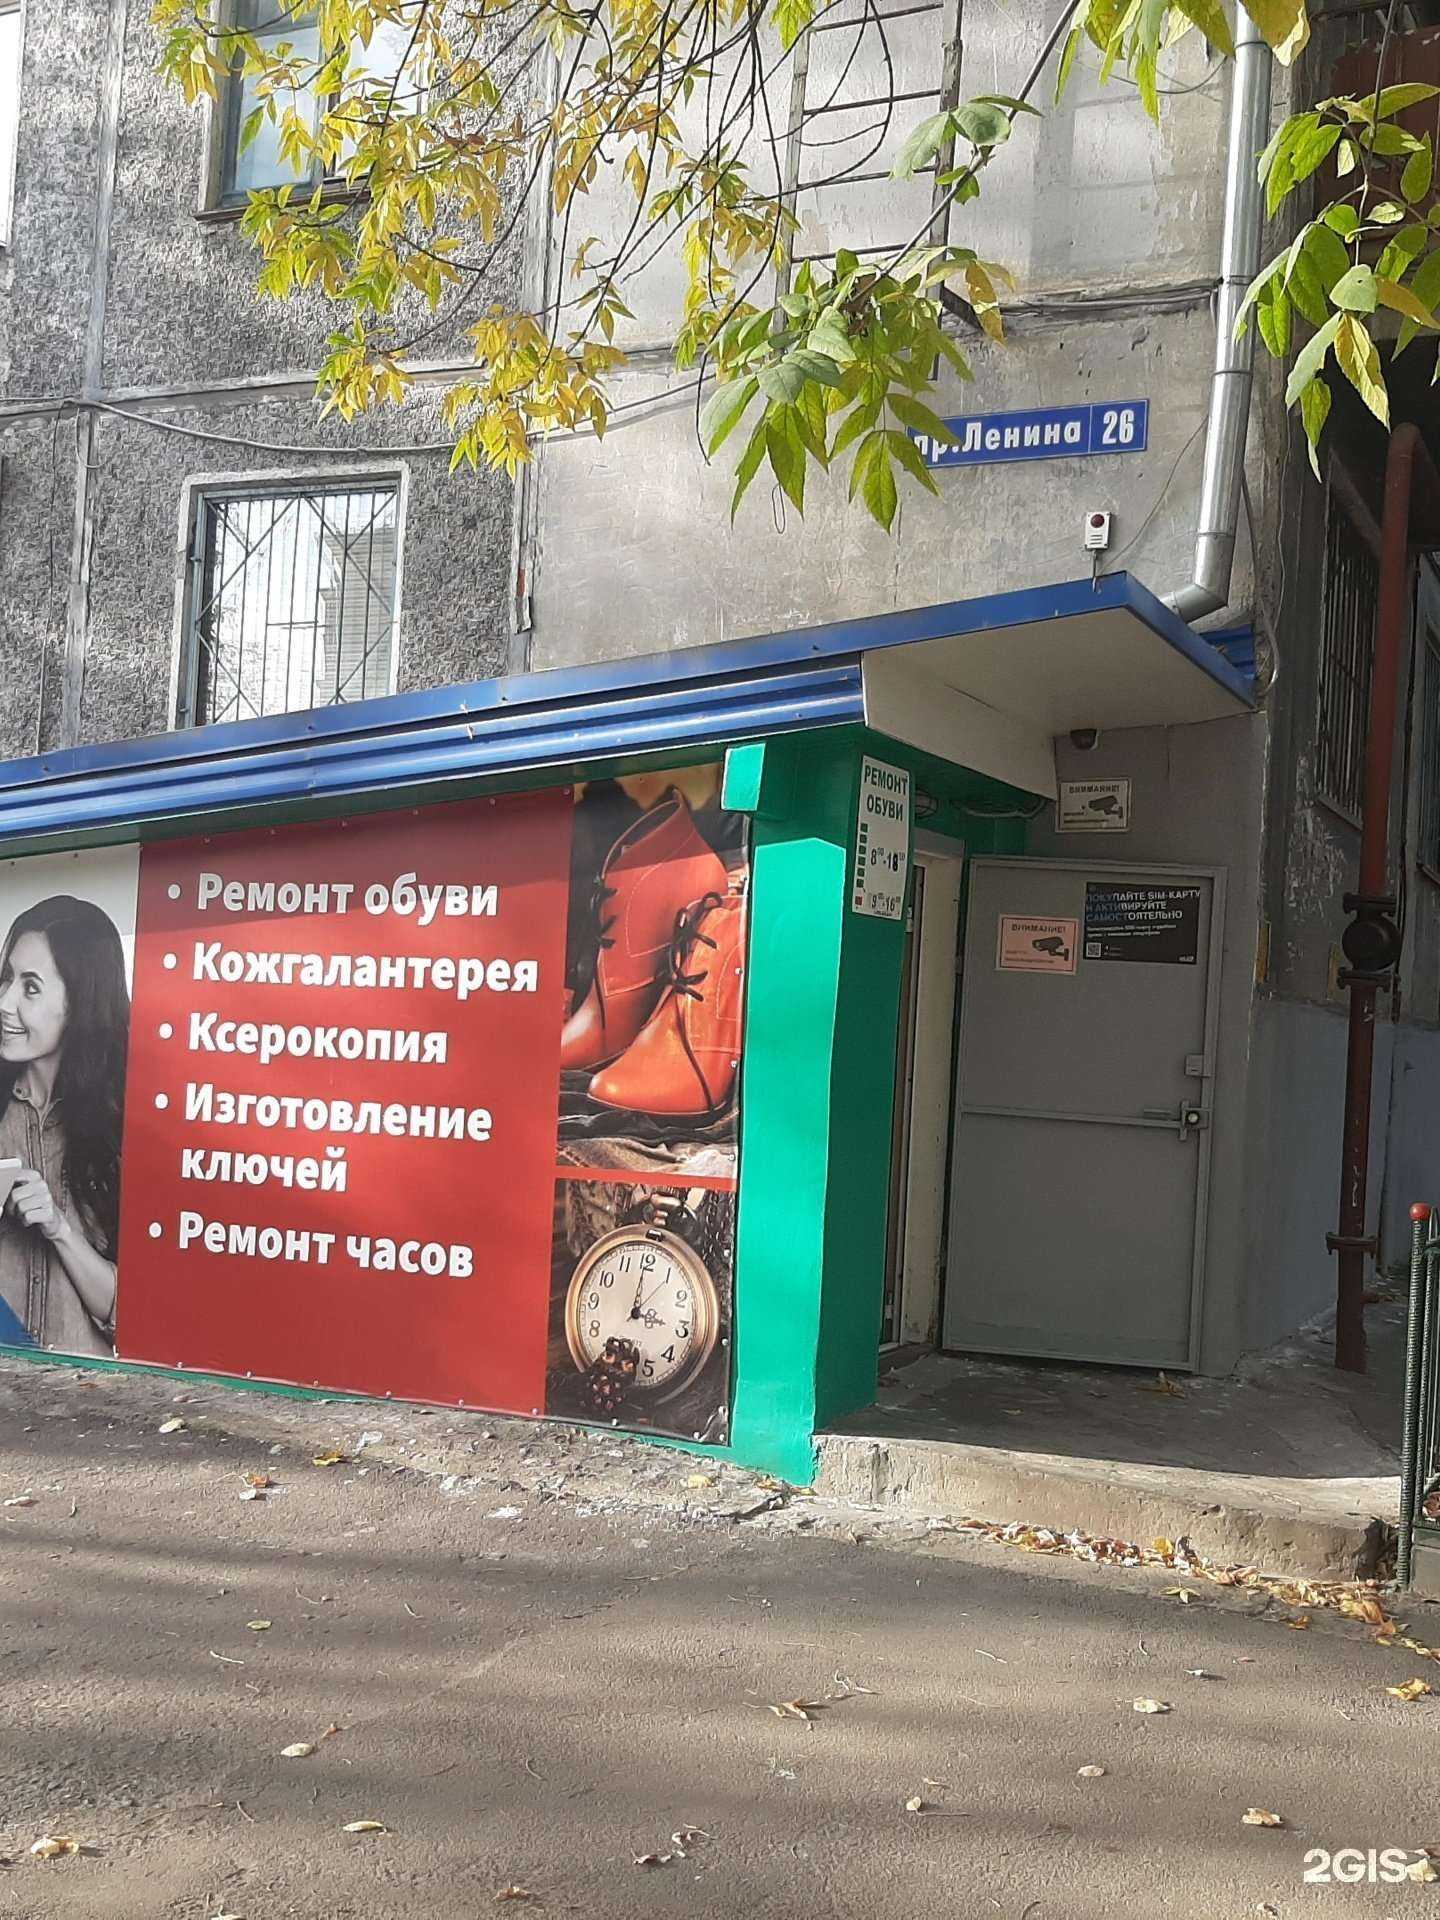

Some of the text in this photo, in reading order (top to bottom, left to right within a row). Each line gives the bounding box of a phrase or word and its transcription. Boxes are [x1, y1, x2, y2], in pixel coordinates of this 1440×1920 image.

[1102, 409, 1135, 445] 26
[864, 765, 908, 795] РЕМОНТ
[867, 794, 903, 821] ОБУВИ
[198, 872, 498, 925] Ремонт обуви
[193, 942, 538, 1000] Кожгалантерея
[188, 1012, 447, 1064] Ксерокопия
[184, 1082, 492, 1141] Изготовление
[181, 1146, 348, 1192] ключей
[178, 1211, 473, 1278] Ремонт часов
[619, 1255, 631, 1273] 11
[640, 1253, 656, 1272] 12
[600, 1270, 614, 1288] 10
[588, 1292, 599, 1310] 9
[675, 1290, 688, 1308] 2
[589, 1320, 601, 1338] 8
[675, 1320, 690, 1339] 3
[660, 1345, 675, 1363] 4
[642, 1359, 655, 1377] 5
